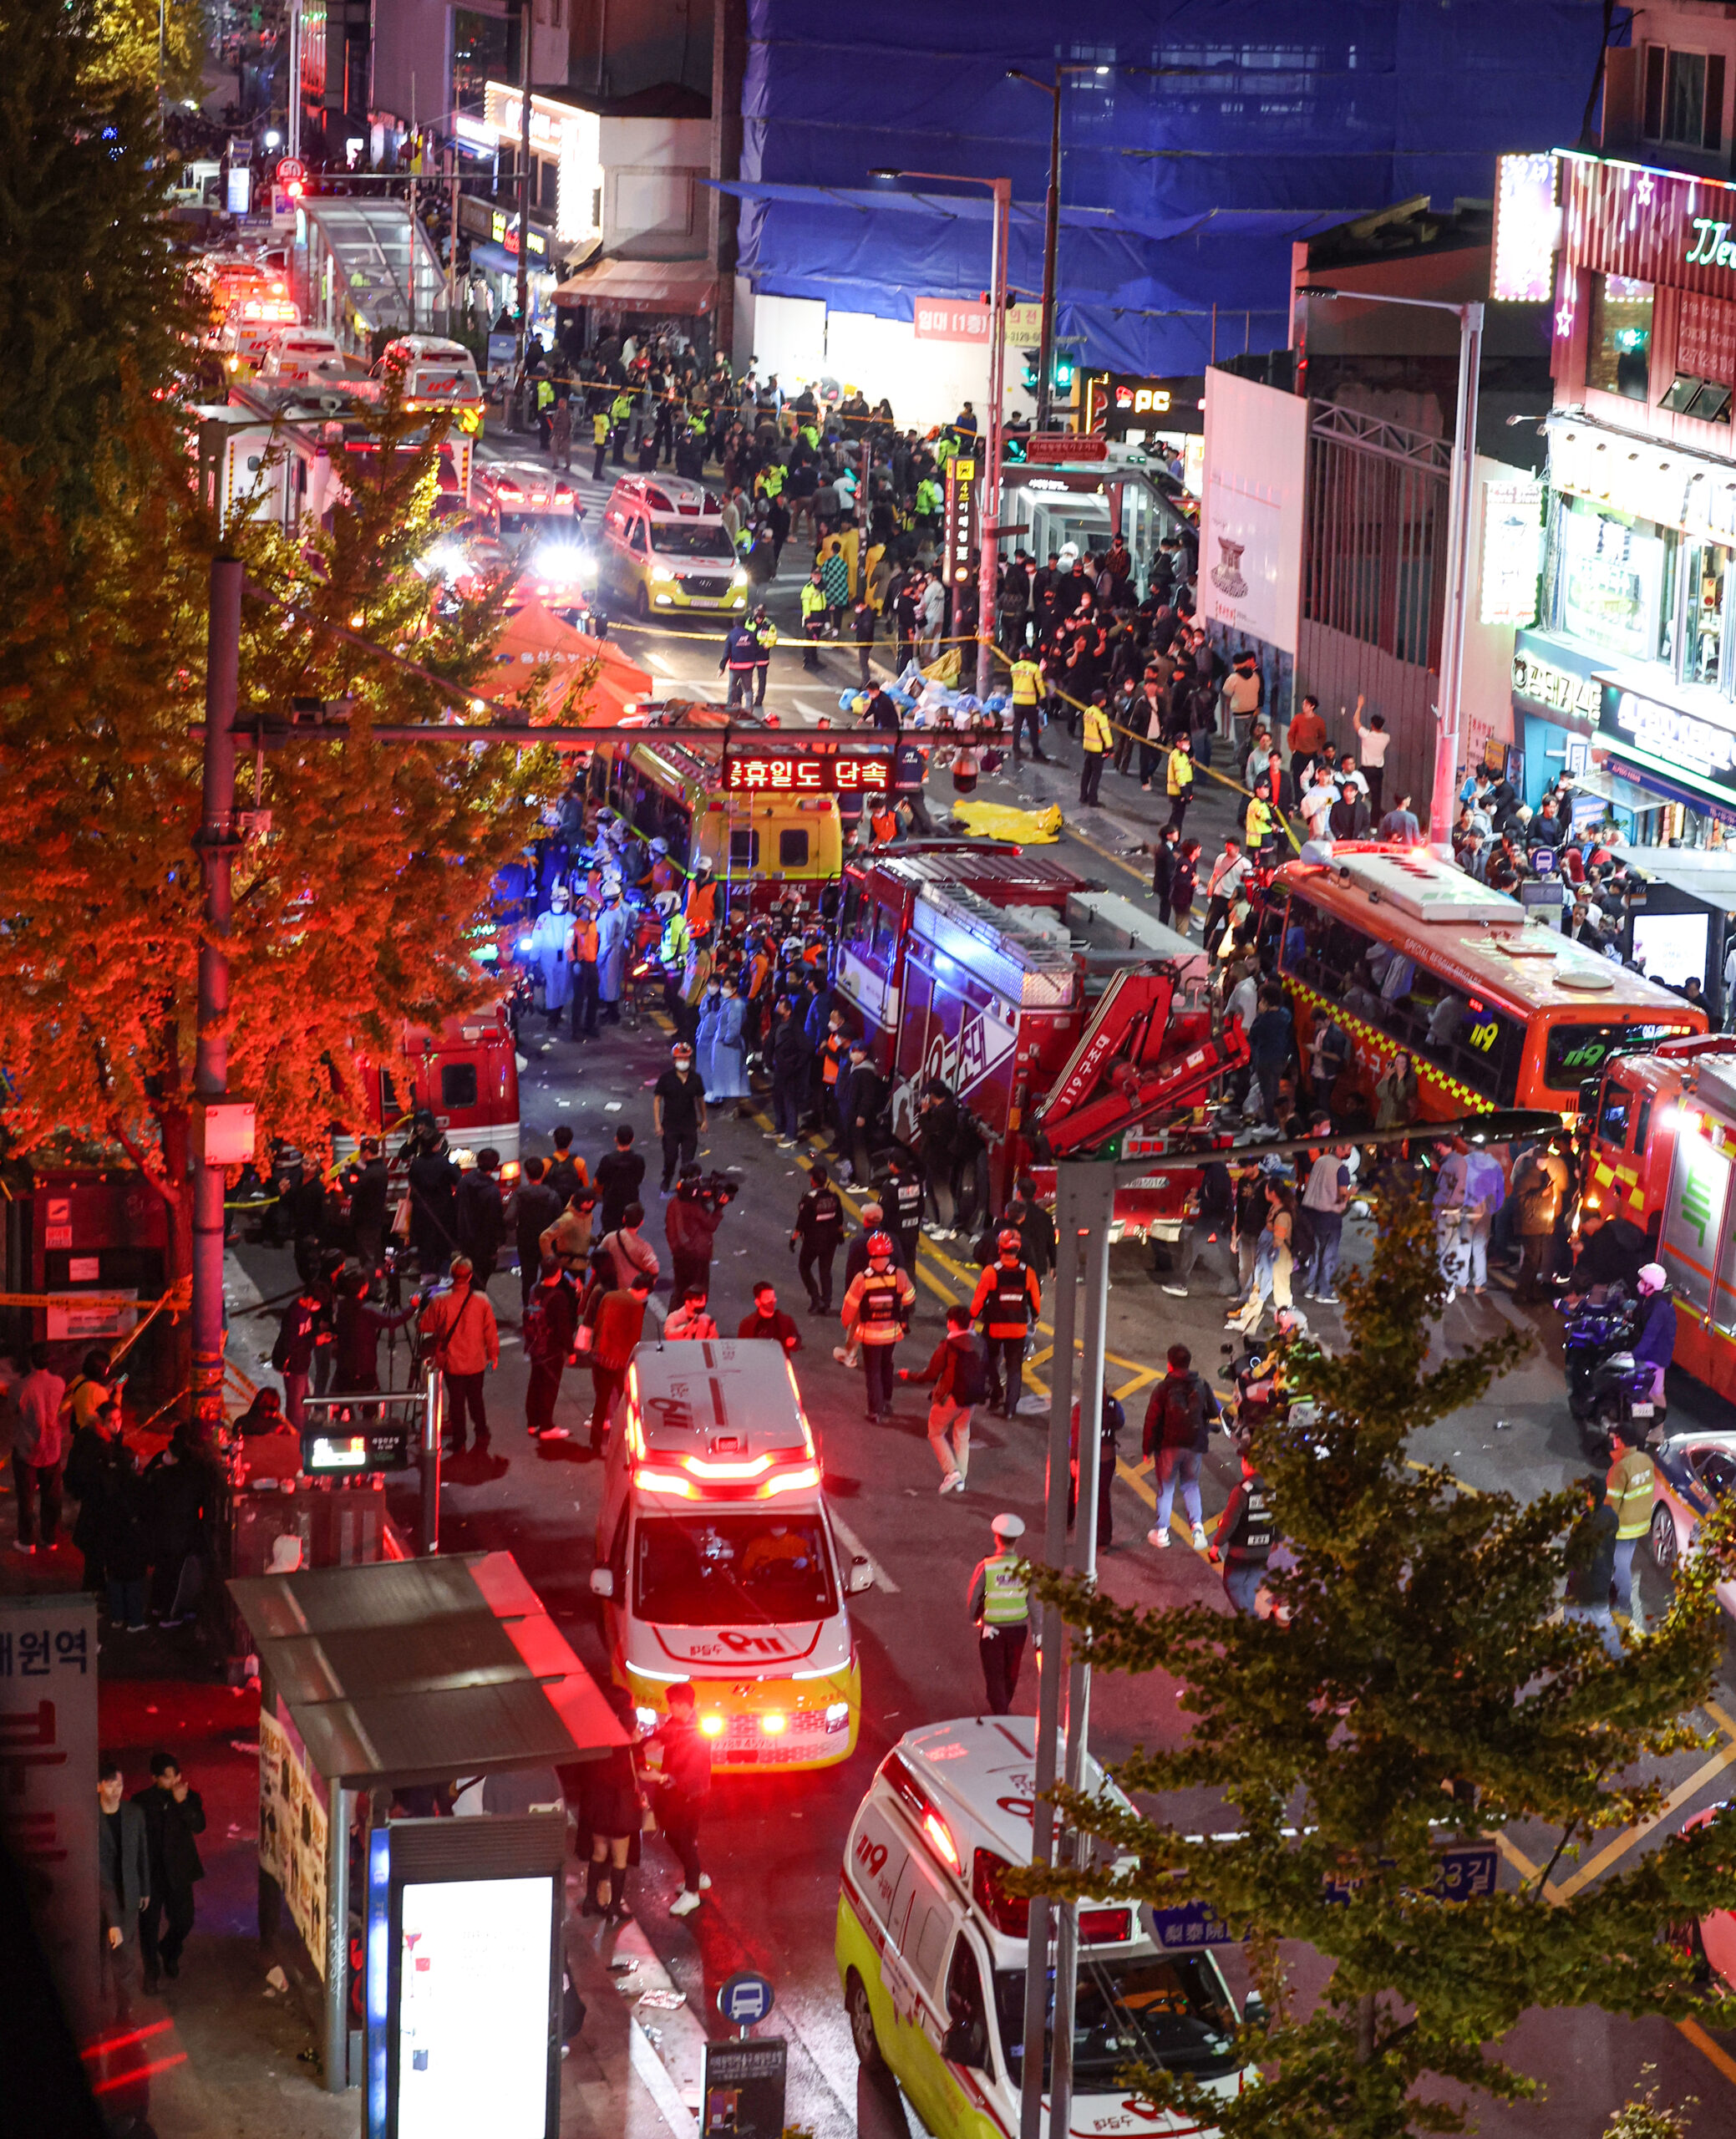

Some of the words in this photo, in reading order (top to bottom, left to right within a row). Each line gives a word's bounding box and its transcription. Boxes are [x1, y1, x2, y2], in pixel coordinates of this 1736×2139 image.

[918, 310, 947, 331] 임대
[427, 378, 457, 393] 119
[960, 481, 968, 493] 4
[835, 761, 886, 787] 단속
[1405, 937, 1429, 959] SPECIAL
[1469, 1022, 1500, 1053] 119
[1562, 1044, 1607, 1067] 119
[1059, 1076, 1083, 1106] 119
[1078, 1034, 1111, 1076] 구조대
[855, 1835, 889, 1879] 119
